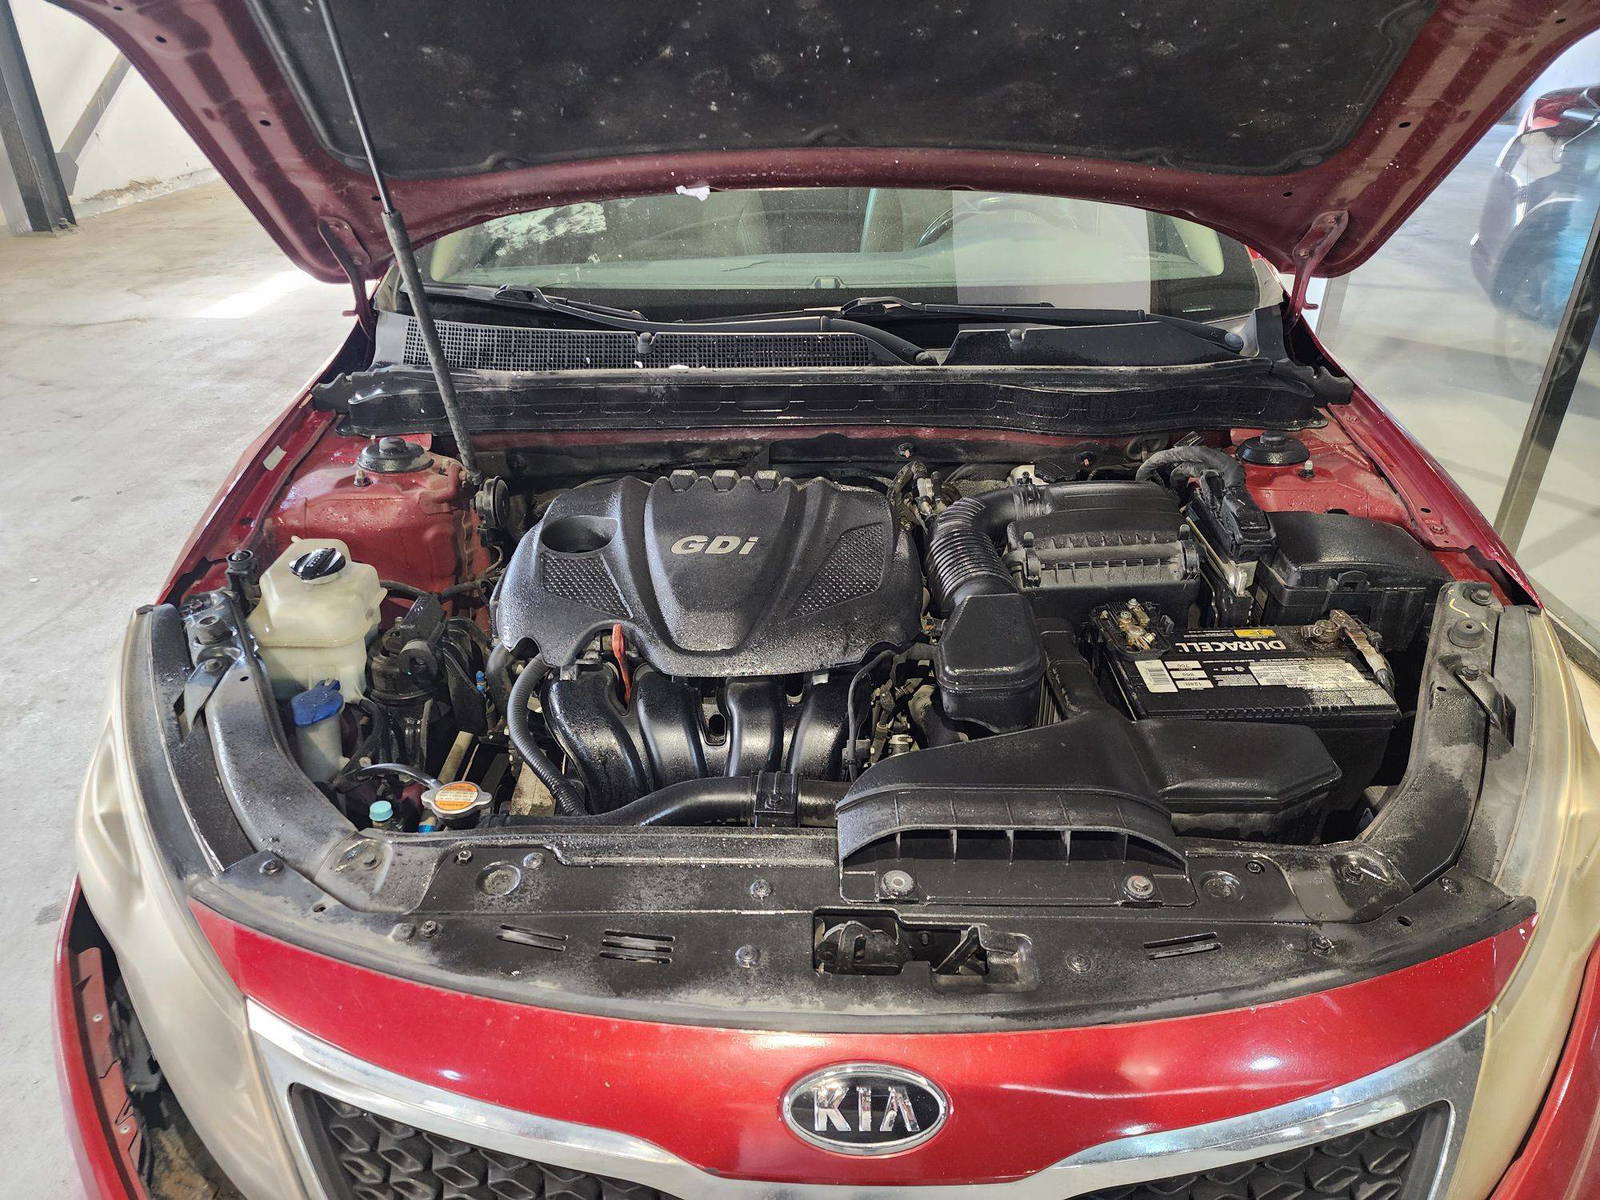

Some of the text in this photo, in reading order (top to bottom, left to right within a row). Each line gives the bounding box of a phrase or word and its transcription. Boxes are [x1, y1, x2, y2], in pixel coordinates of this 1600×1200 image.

[671, 535, 759, 555] GDi
[1175, 640, 1287, 652] DURACELL
[814, 1086, 920, 1132] KIA
